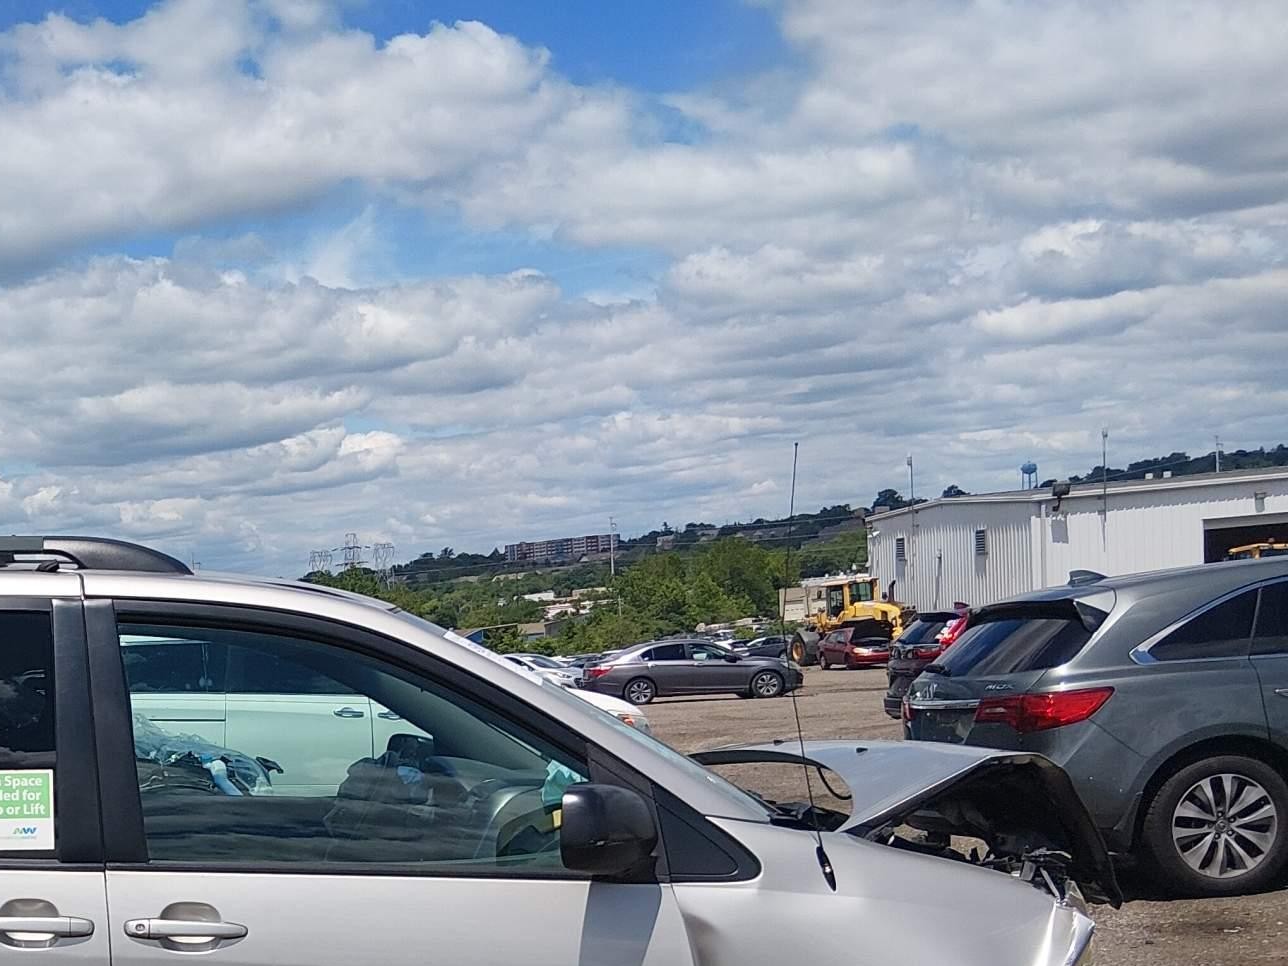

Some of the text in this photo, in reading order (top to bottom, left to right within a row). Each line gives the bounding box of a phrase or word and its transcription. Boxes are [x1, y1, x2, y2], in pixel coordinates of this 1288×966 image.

[4, 775, 43, 789] Space
[22, 789, 41, 801] for
[6, 805, 21, 815] or
[23, 803, 46, 815] Lift
